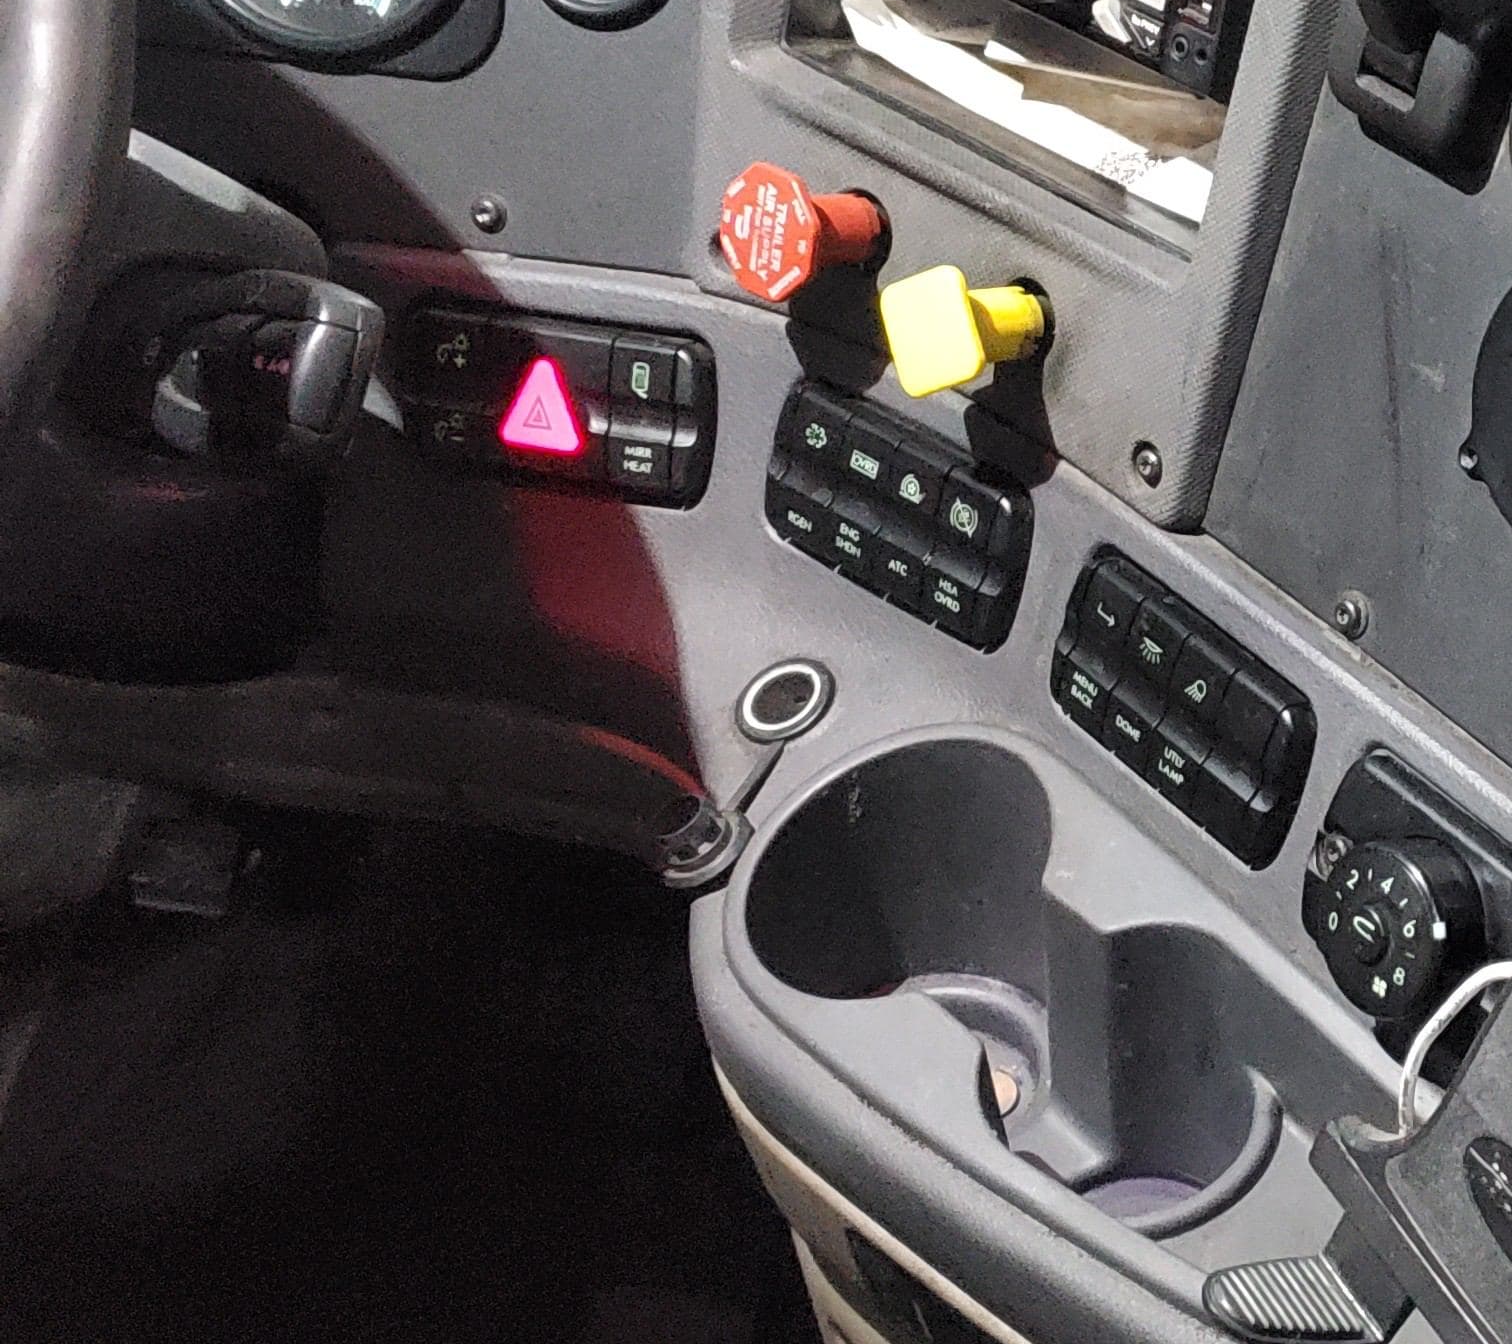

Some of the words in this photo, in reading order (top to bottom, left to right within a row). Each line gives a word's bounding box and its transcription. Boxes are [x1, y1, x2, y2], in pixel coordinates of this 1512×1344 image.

[770, 203, 788, 272] TRAILER
[623, 460, 653, 474] HEAT
[840, 522, 860, 542] ENG
[888, 559, 908, 576] ATC
[939, 578, 958, 597] HSA
[934, 591, 960, 613] OVRD
[1072, 671, 1098, 697] MENU
[1071, 685, 1094, 710] BACK
[1115, 714, 1141, 743] DOME
[1158, 758, 1184, 786] LAMP
[1346, 869, 1359, 890] 2
[1380, 876, 1394, 895] 4
[1328, 911, 1339, 931] 0
[1403, 919, 1417, 938] 6
[1393, 967, 1405, 986] 8
